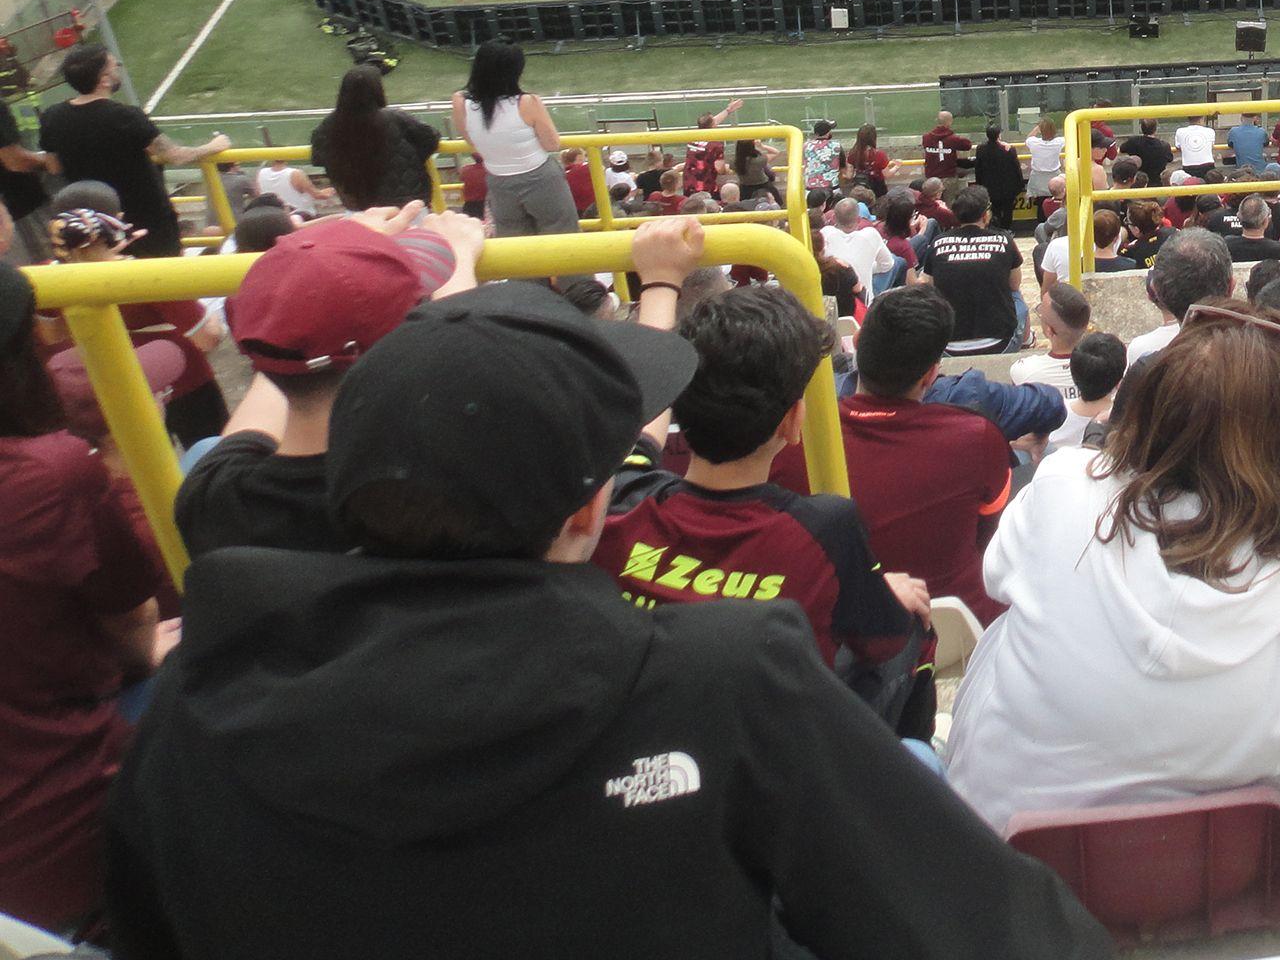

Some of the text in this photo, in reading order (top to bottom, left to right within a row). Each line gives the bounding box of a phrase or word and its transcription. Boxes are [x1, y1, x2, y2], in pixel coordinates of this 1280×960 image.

[934, 236, 968, 248] ETERNA
[936, 244, 957, 256] ALLA
[959, 244, 977, 252] MIA
[948, 252, 992, 262] SALERNO
[655, 554, 786, 601] Zeus
[632, 752, 669, 774] THE
[605, 769, 671, 797] NORTH
[624, 783, 671, 808] FACE
